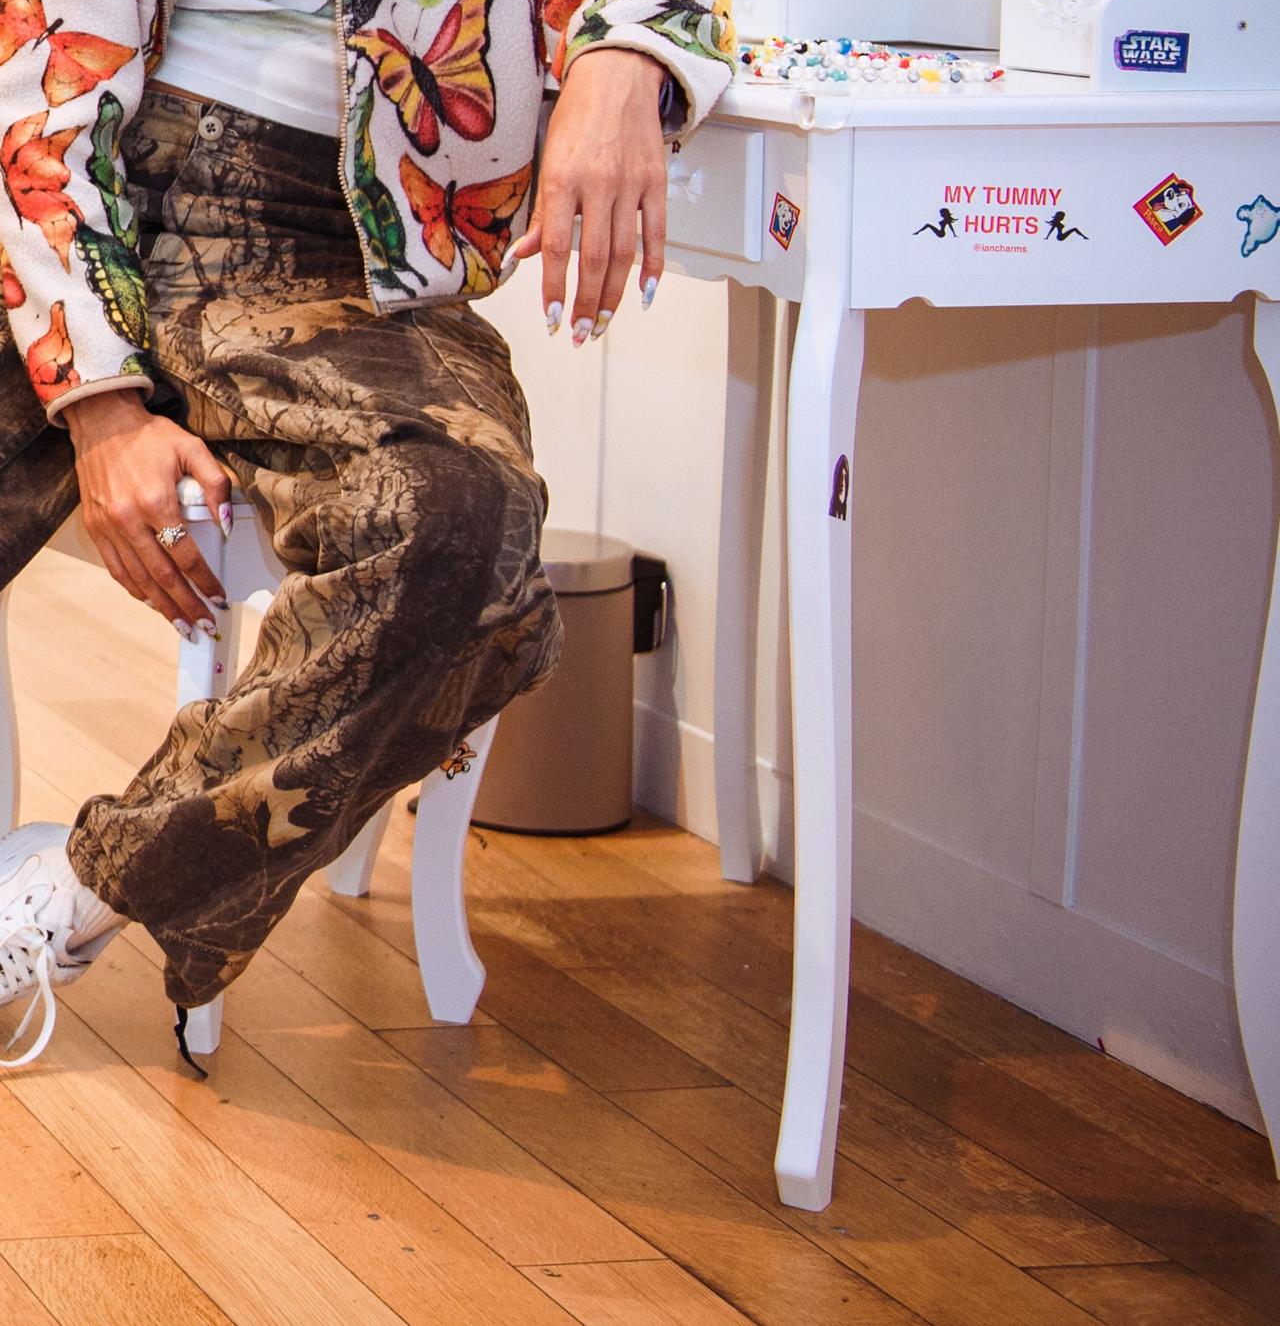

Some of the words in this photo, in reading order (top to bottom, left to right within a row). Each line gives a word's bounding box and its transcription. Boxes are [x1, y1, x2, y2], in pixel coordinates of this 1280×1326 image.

[1122, 35, 1181, 52] STAR
[1122, 49, 1181, 65] WARS
[944, 185, 976, 204] MY
[983, 186, 1062, 206] TUMMY
[964, 215, 1039, 235] HURTS
[973, 243, 1028, 253] @iancharms
